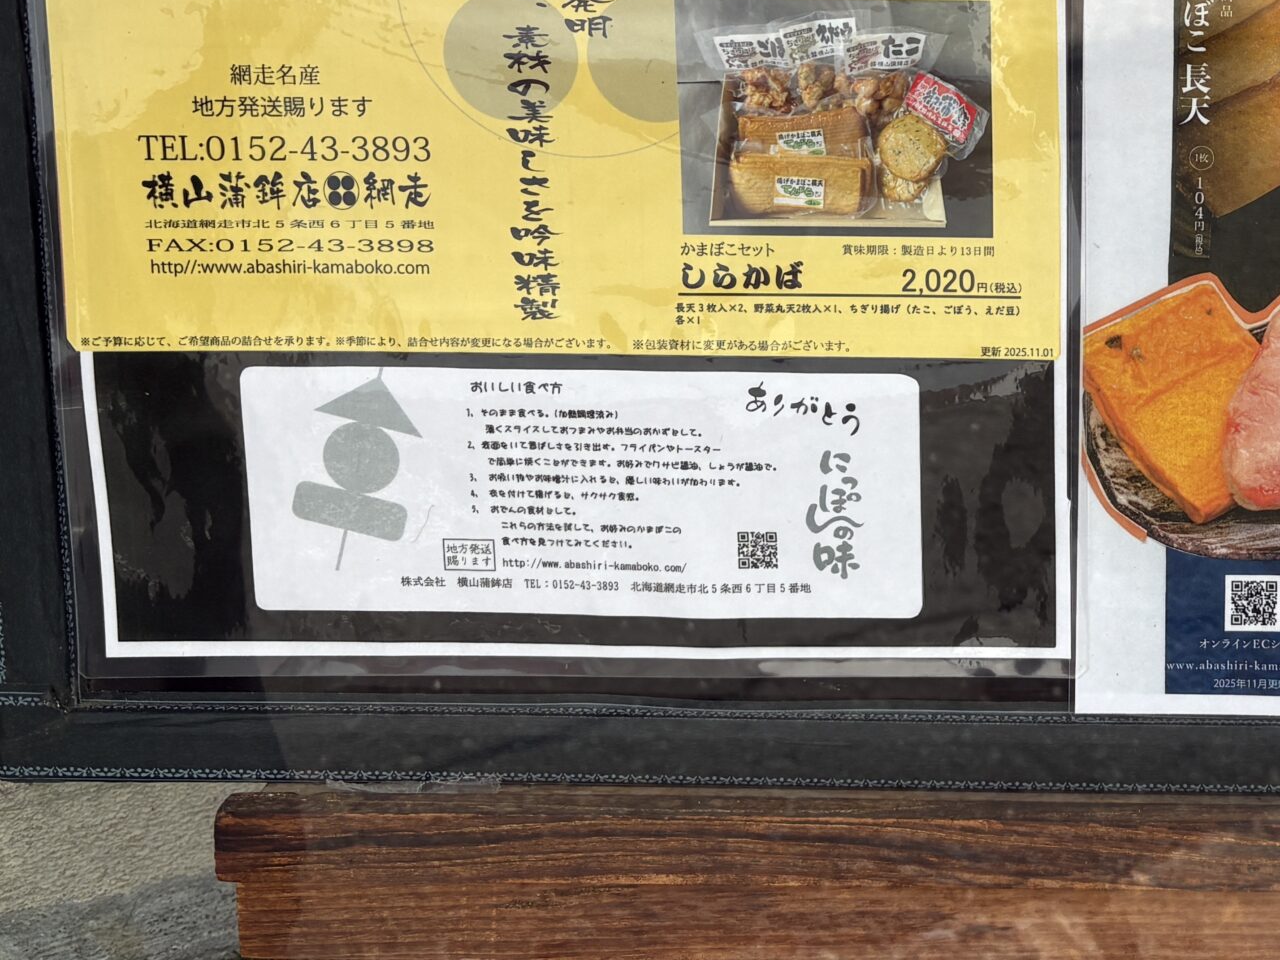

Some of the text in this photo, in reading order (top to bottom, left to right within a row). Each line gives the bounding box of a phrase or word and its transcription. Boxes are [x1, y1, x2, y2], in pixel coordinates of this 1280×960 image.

[230, 64, 320, 86] 網走名産
[191, 96, 373, 118] 地方発送賜ります
[138, 135, 431, 162] TEL:0152-43-3893
[146, 238, 434, 252] FAX:0152-43-3898
[680, 243, 775, 257] かまぼこセット
[681, 261, 804, 290] しらかば
[470, 381, 563, 394] おいしい食べ方
[746, 381, 860, 436] ありがとう
[446, 543, 492, 555] 地方発送
[401, 576, 446, 587] 株式会社
